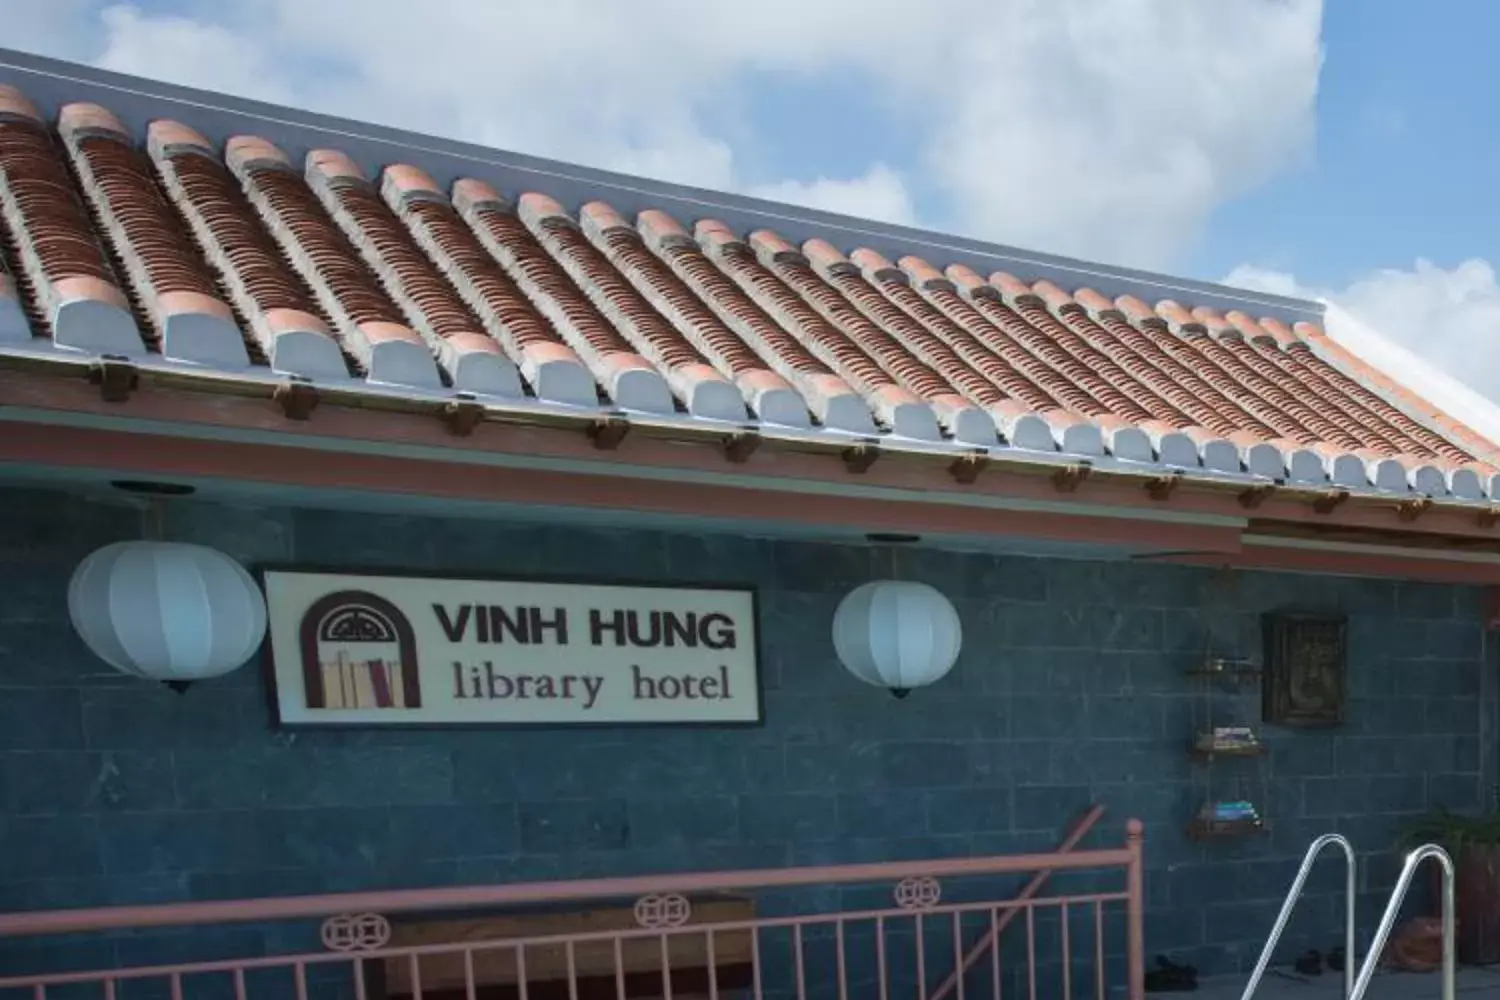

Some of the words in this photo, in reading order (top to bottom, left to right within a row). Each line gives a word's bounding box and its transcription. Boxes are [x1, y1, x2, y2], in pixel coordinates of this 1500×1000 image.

[432, 603, 568, 645] VINH
[589, 609, 737, 649] HUNG
[453, 661, 604, 709] library
[631, 664, 732, 700] hotel
